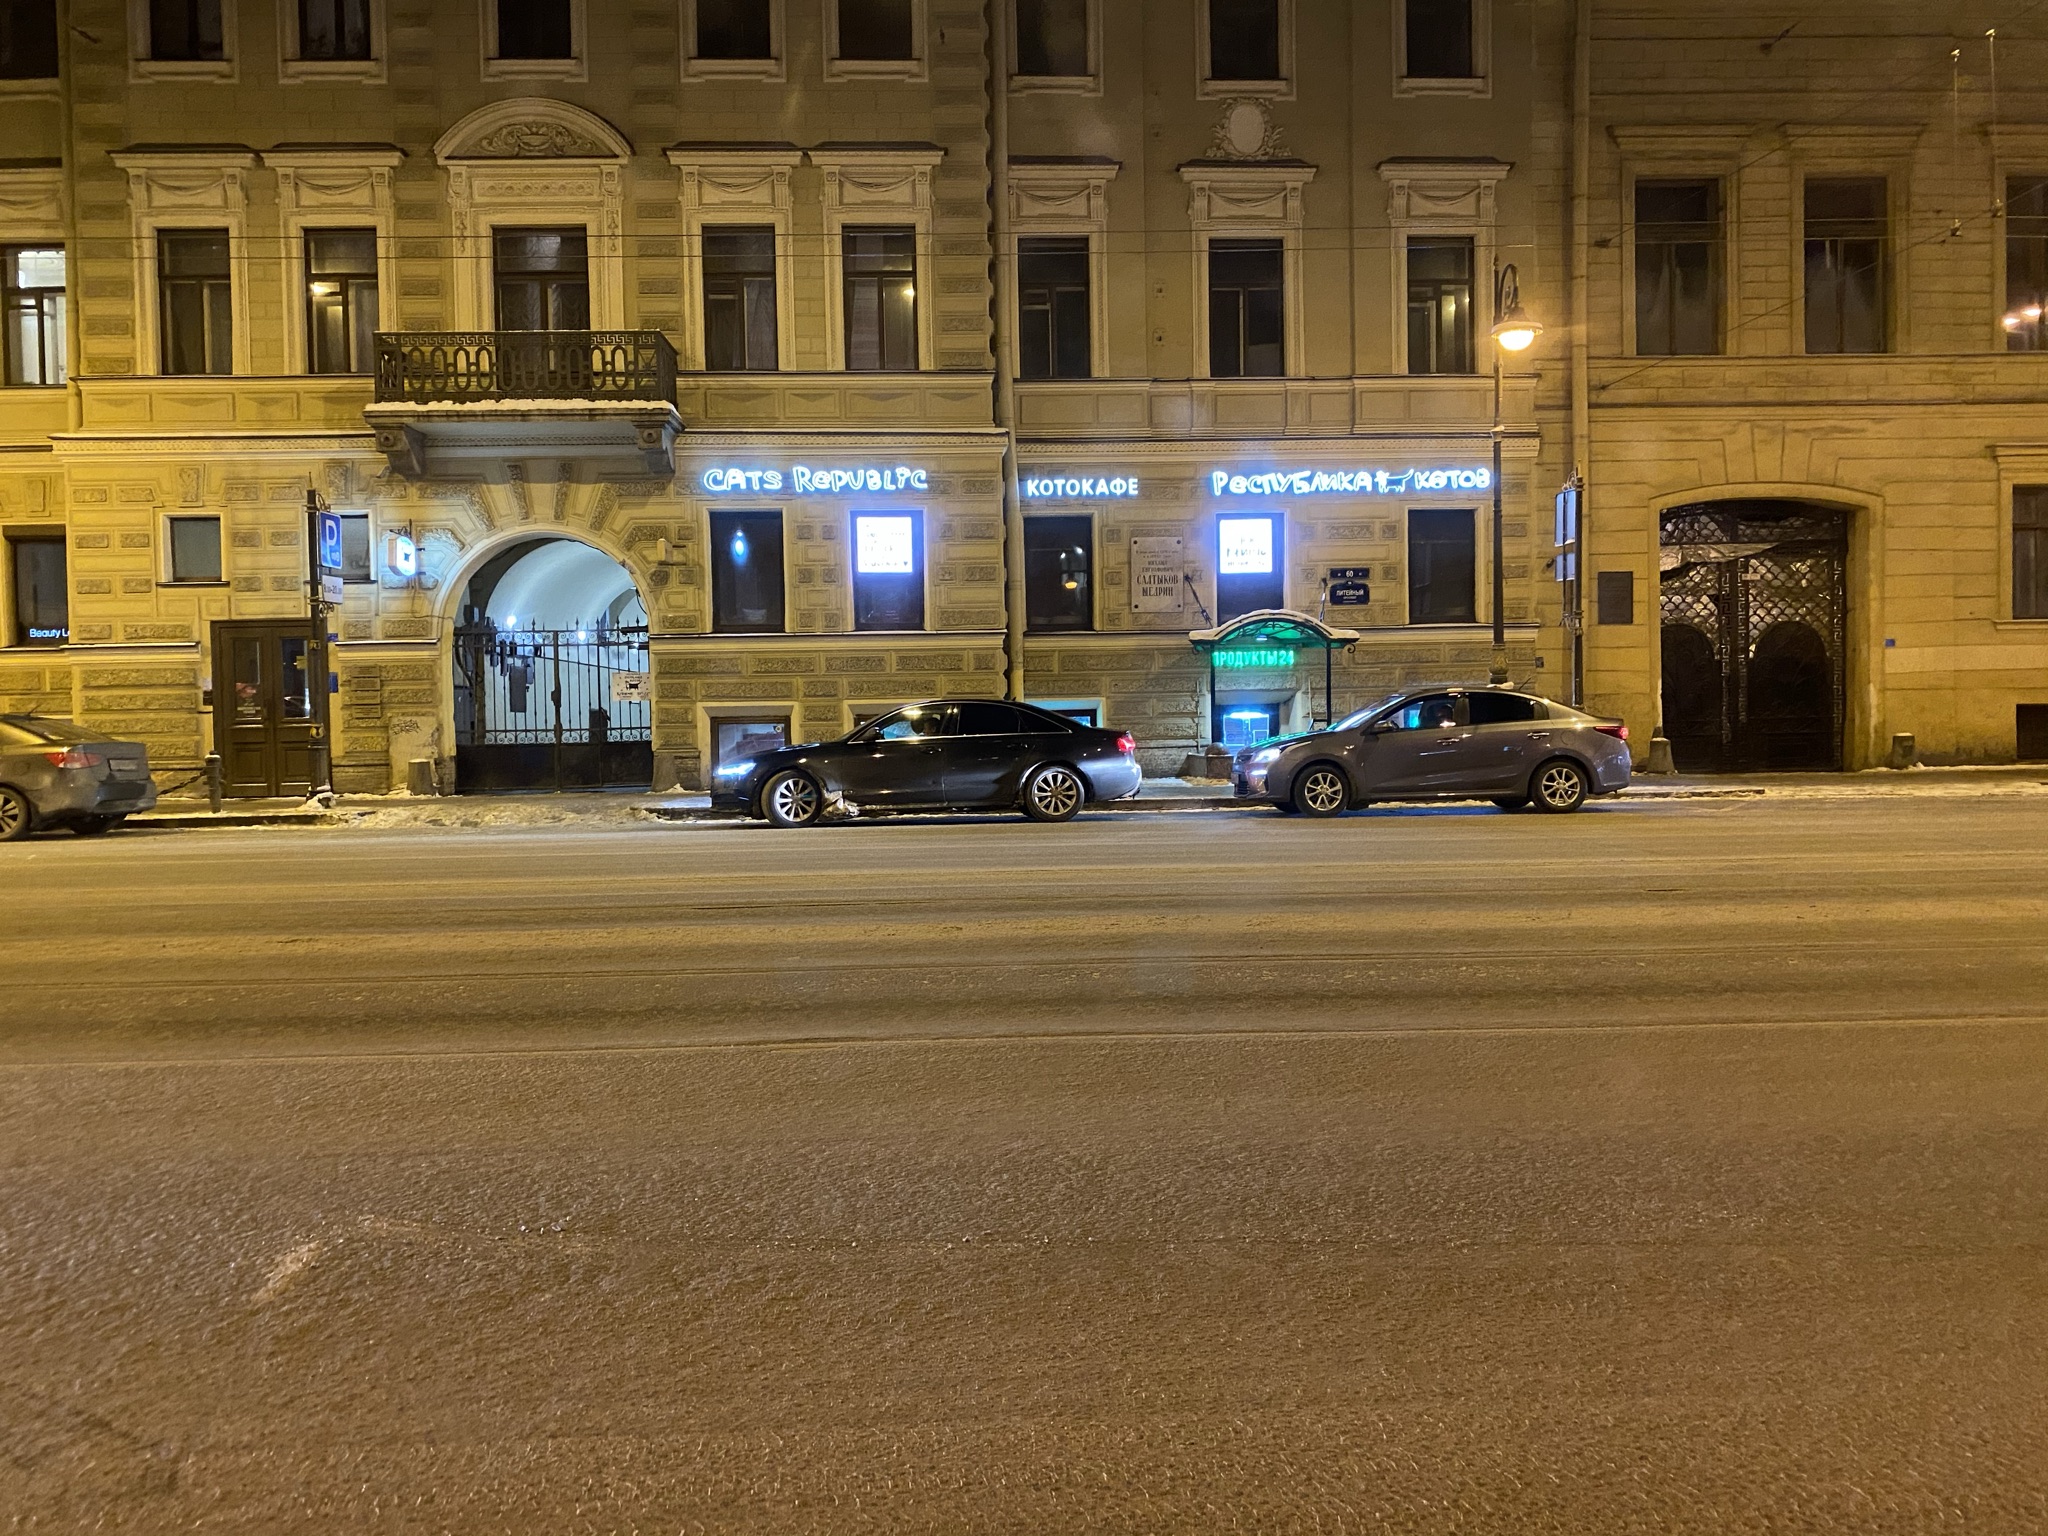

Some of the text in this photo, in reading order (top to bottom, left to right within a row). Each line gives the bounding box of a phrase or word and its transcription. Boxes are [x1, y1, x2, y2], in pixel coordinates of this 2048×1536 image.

[1027, 478, 1138, 496] КОТОКАФЕ
[1136, 574, 1179, 585] САЛТЫКОВ
[29, 628, 60, 639] Beauty
